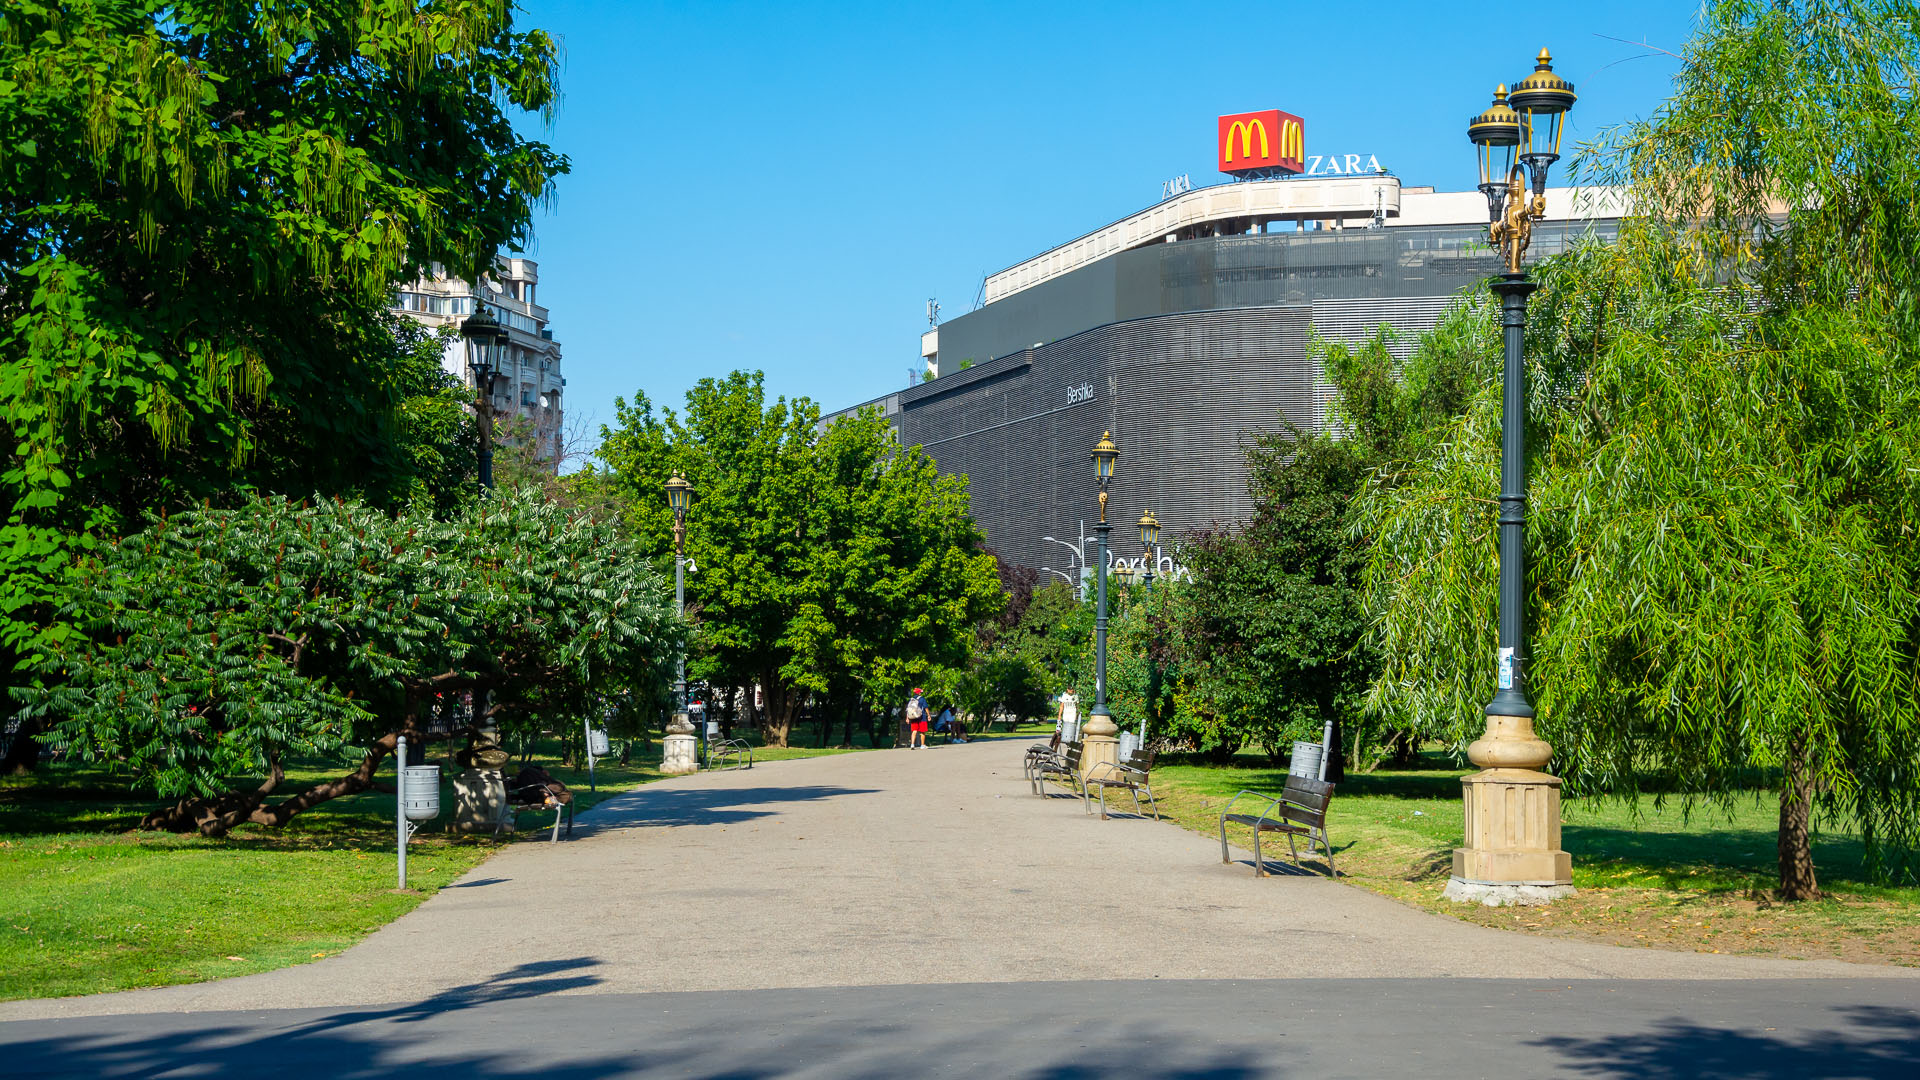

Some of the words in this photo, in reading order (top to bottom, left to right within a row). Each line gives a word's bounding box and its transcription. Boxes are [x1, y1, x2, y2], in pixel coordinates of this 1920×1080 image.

[1307, 153, 1384, 175] ZARA
[1161, 173, 1191, 200] ZARA
[1067, 382, 1094, 404] Bershka
